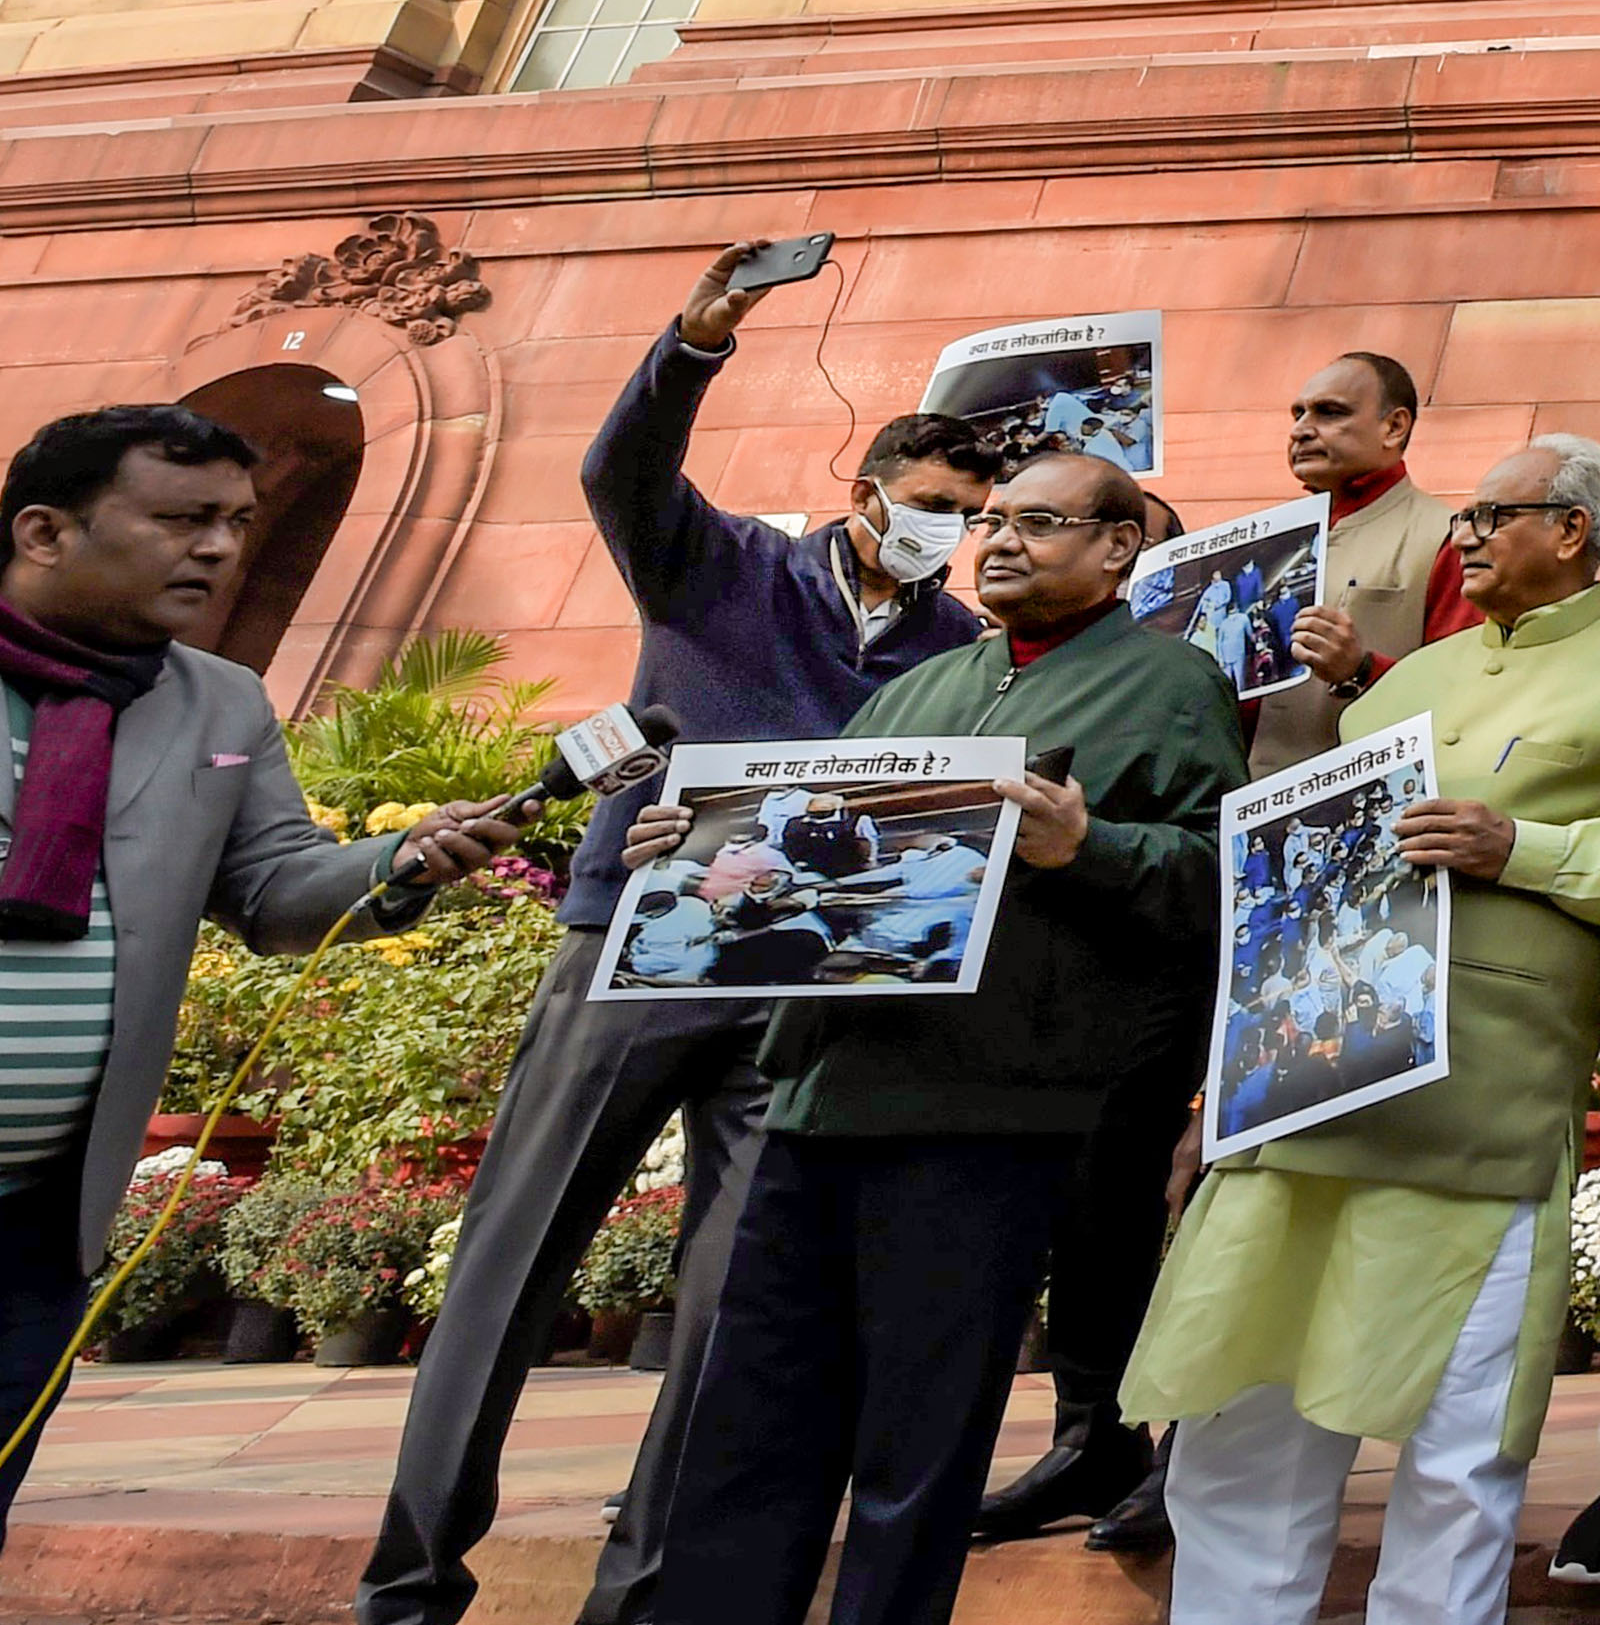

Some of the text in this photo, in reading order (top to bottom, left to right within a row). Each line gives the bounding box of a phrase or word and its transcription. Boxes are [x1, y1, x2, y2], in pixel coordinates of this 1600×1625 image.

[281, 331, 306, 350] 12
[969, 342, 990, 356] क्या
[990, 338, 1008, 352] यह
[1010, 328, 1083, 348] लोकतांत्रिक
[1086, 325, 1095, 342] है
[1168, 546, 1188, 562] क्या
[1190, 540, 1207, 555] यह
[1208, 526, 1248, 551] संसदीय
[1250, 520, 1258, 539] है
[744, 761, 781, 779] क्या
[783, 760, 810, 779] यह
[812, 752, 919, 776] लोकतांत्रिक
[922, 750, 936, 775] है
[1236, 797, 1268, 821] क्या
[1270, 786, 1297, 808] यह
[1298, 746, 1392, 797] लोकतांत्रिक
[1395, 737, 1407, 759] है
